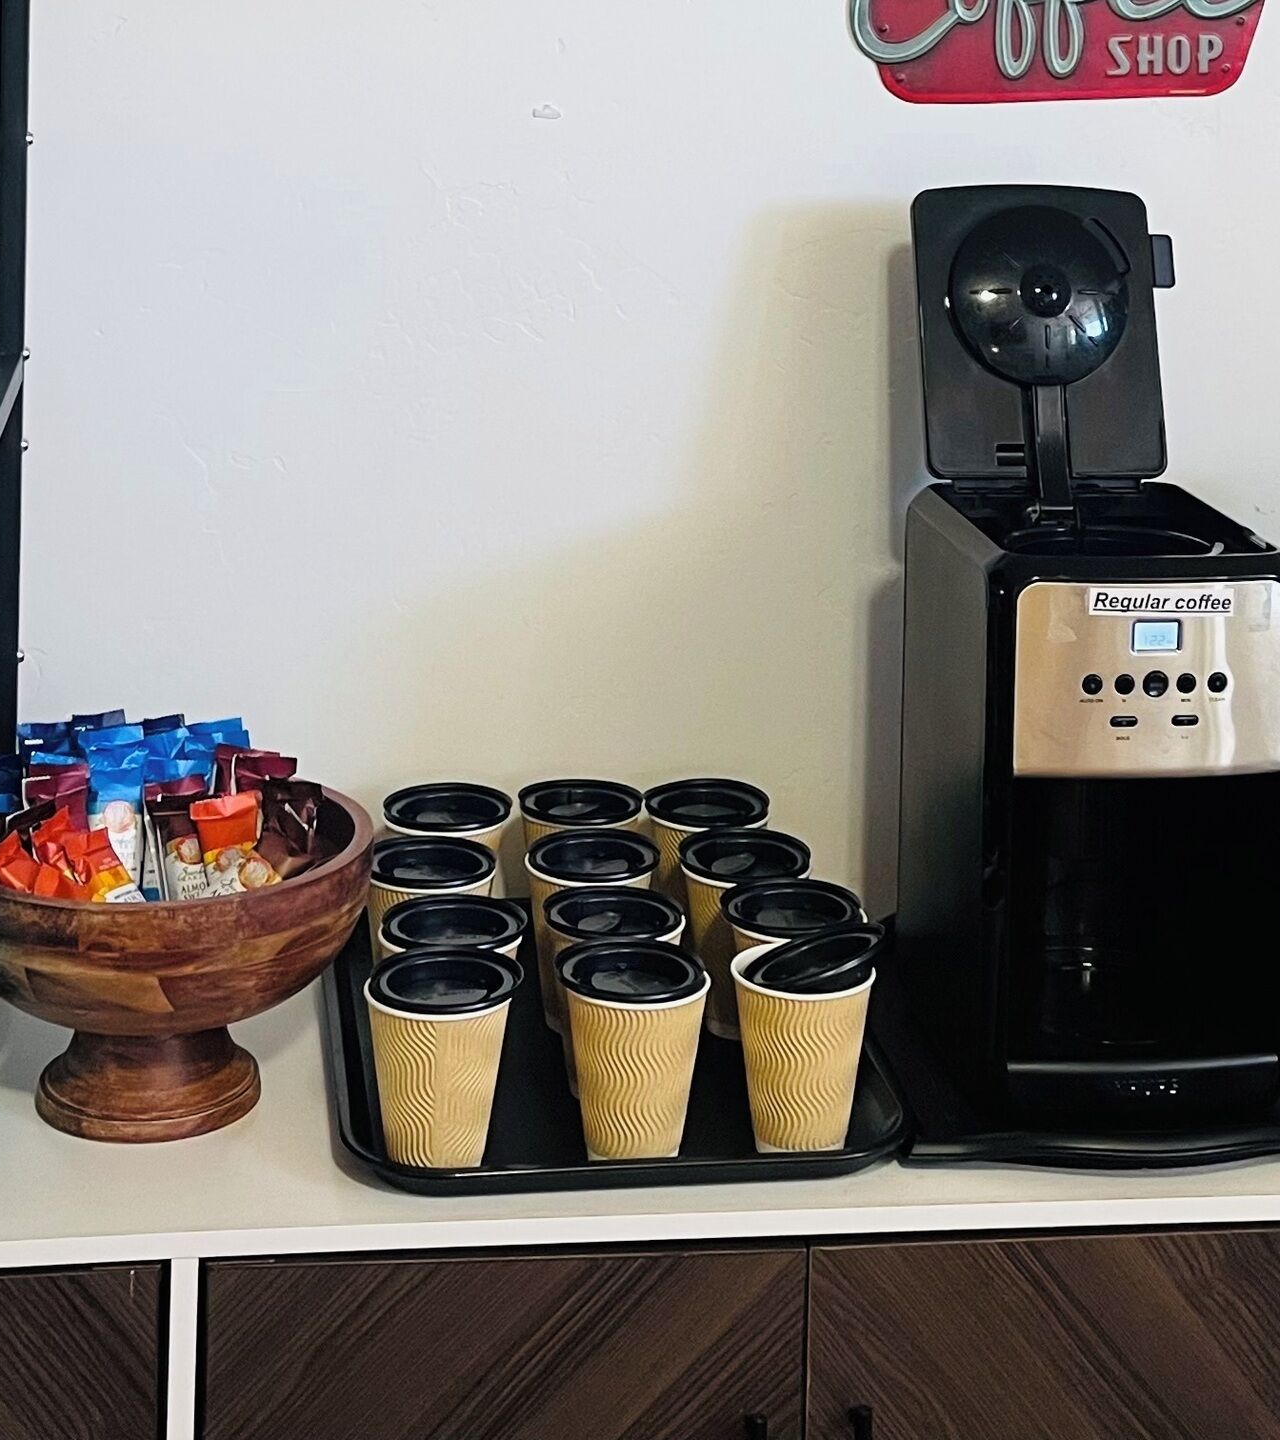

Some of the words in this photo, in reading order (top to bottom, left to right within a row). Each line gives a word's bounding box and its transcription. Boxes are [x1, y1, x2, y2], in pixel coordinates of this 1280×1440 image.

[1106, 34, 1223, 76] SHOP
[1094, 592, 1170, 612] Regular
[1175, 594, 1232, 610] coffee
